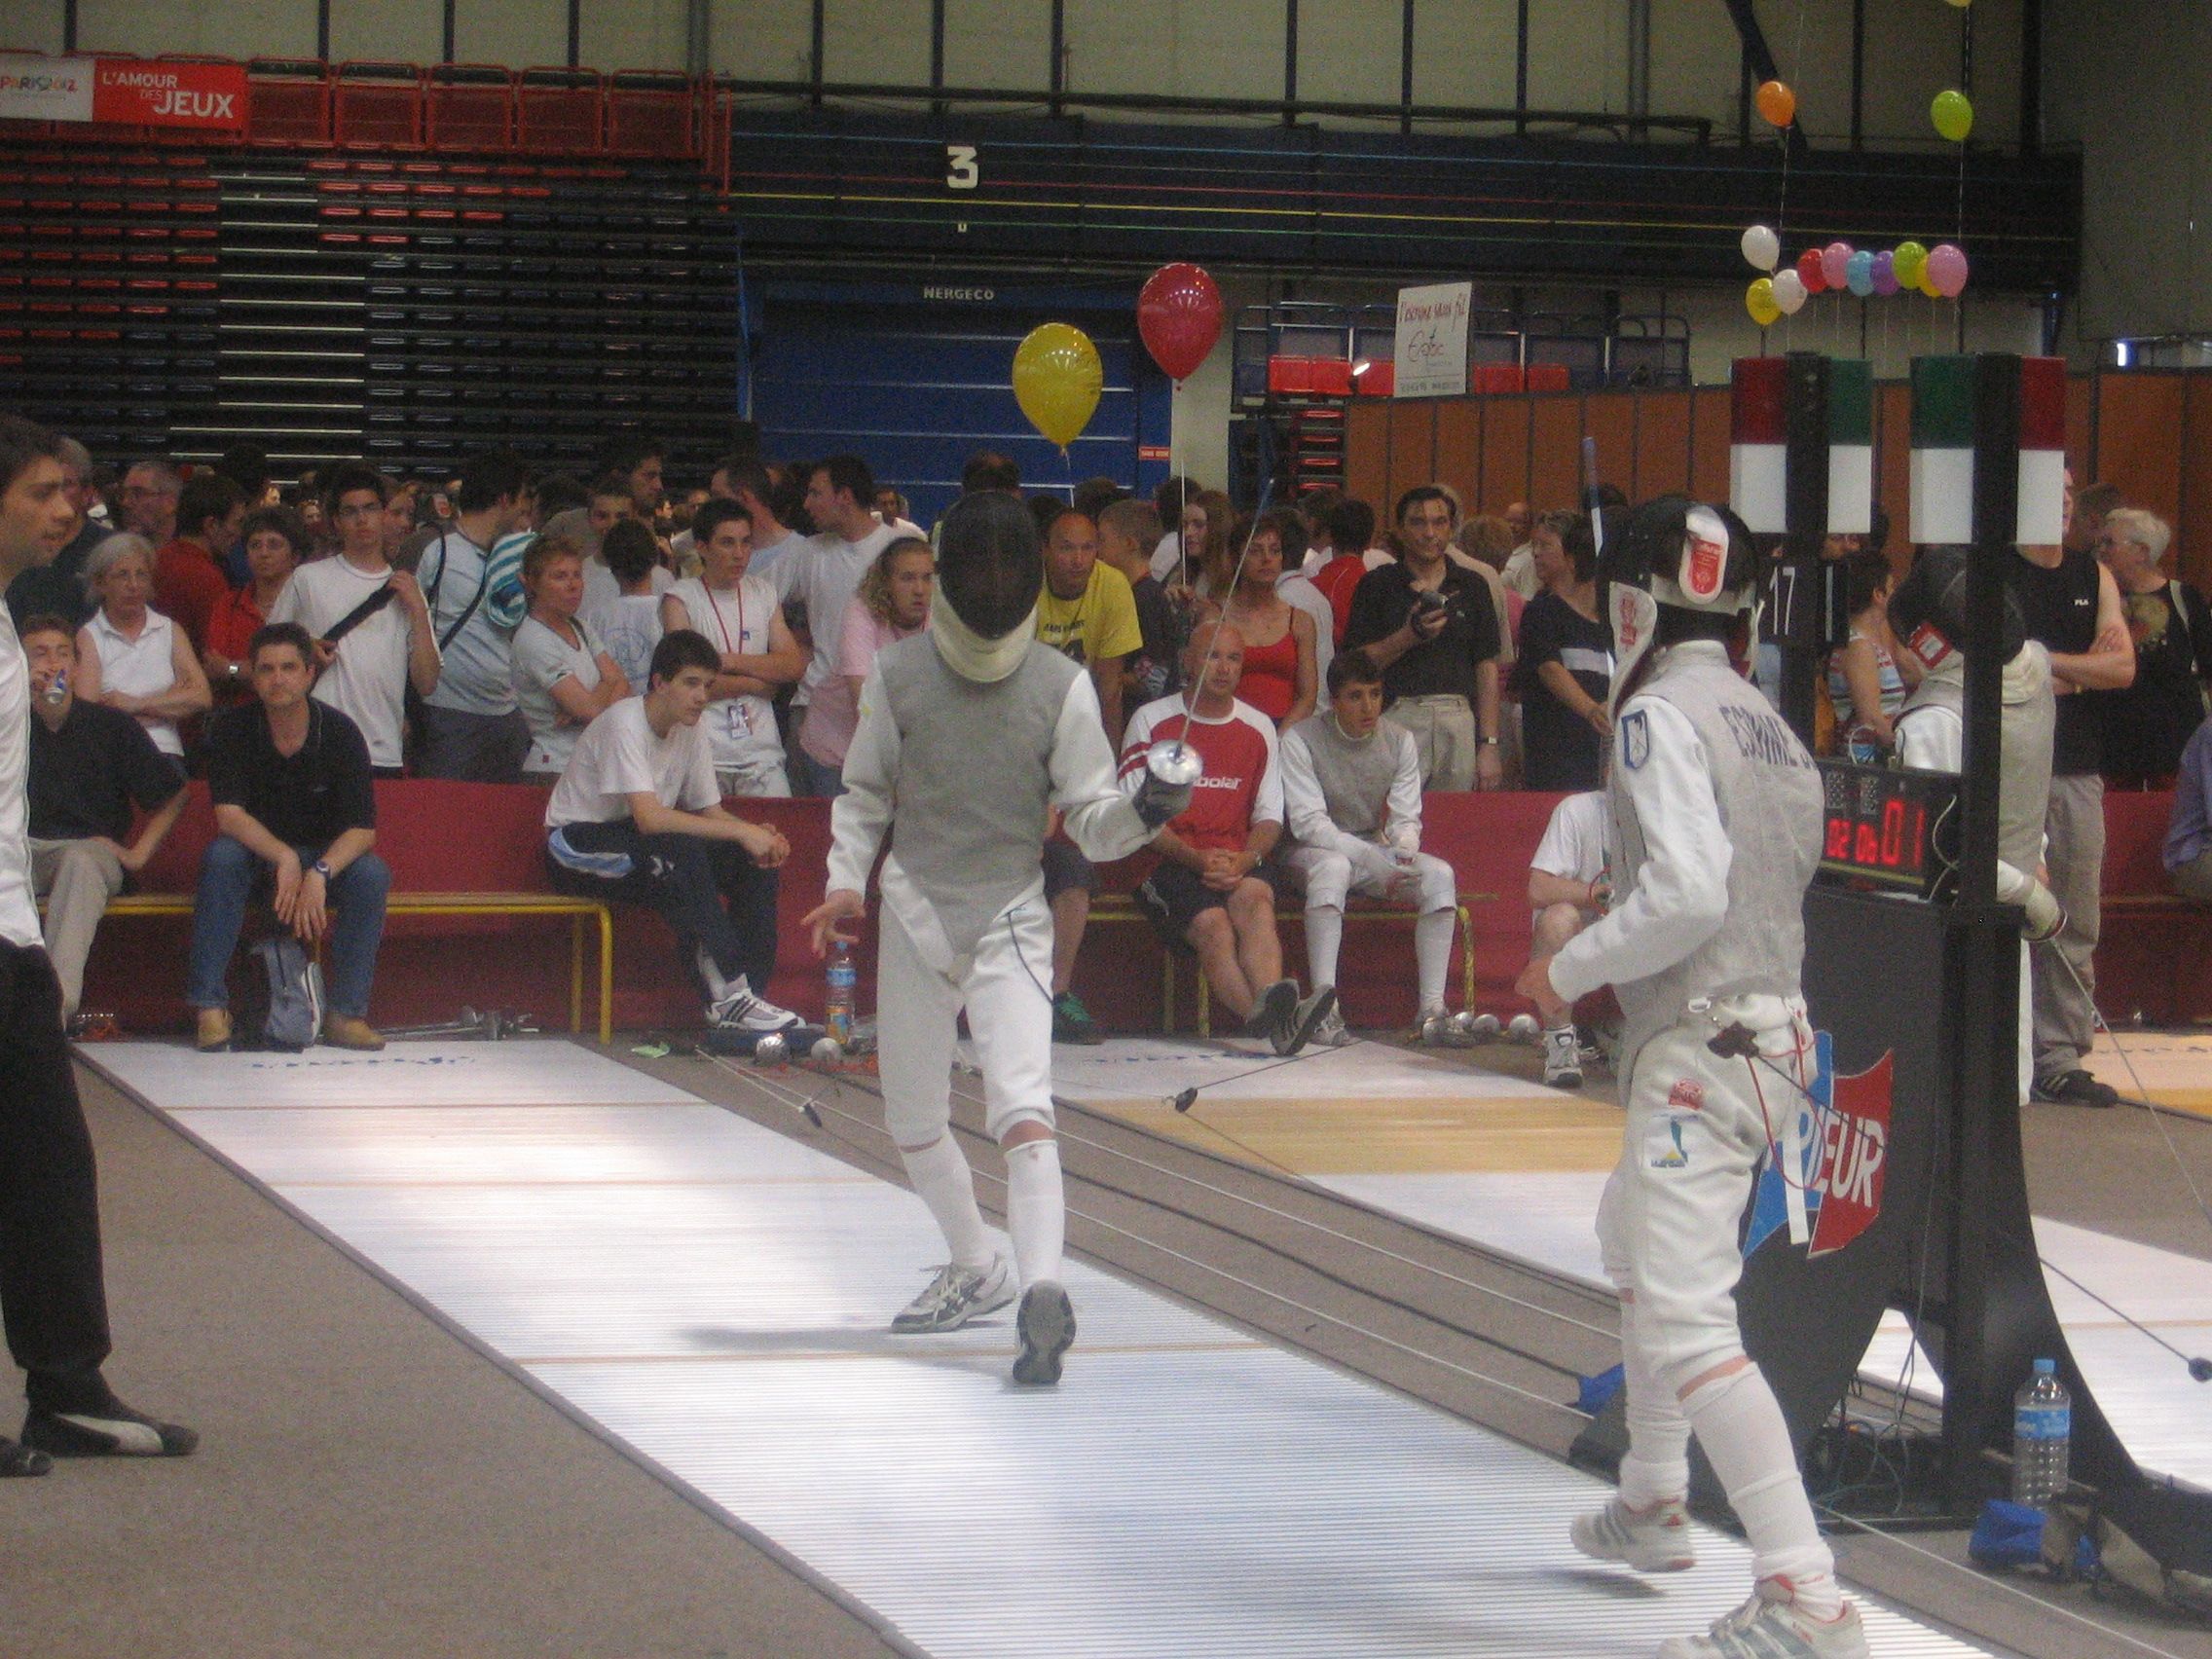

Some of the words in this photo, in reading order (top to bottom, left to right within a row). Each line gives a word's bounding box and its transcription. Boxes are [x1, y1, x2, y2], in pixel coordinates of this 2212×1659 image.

[102, 72, 178, 89] L'AMOUR
[153, 91, 235, 119] JEUX
[946, 145, 979, 189] 3
[923, 287, 995, 301] NERGECO
[1769, 567, 1795, 636] 17
